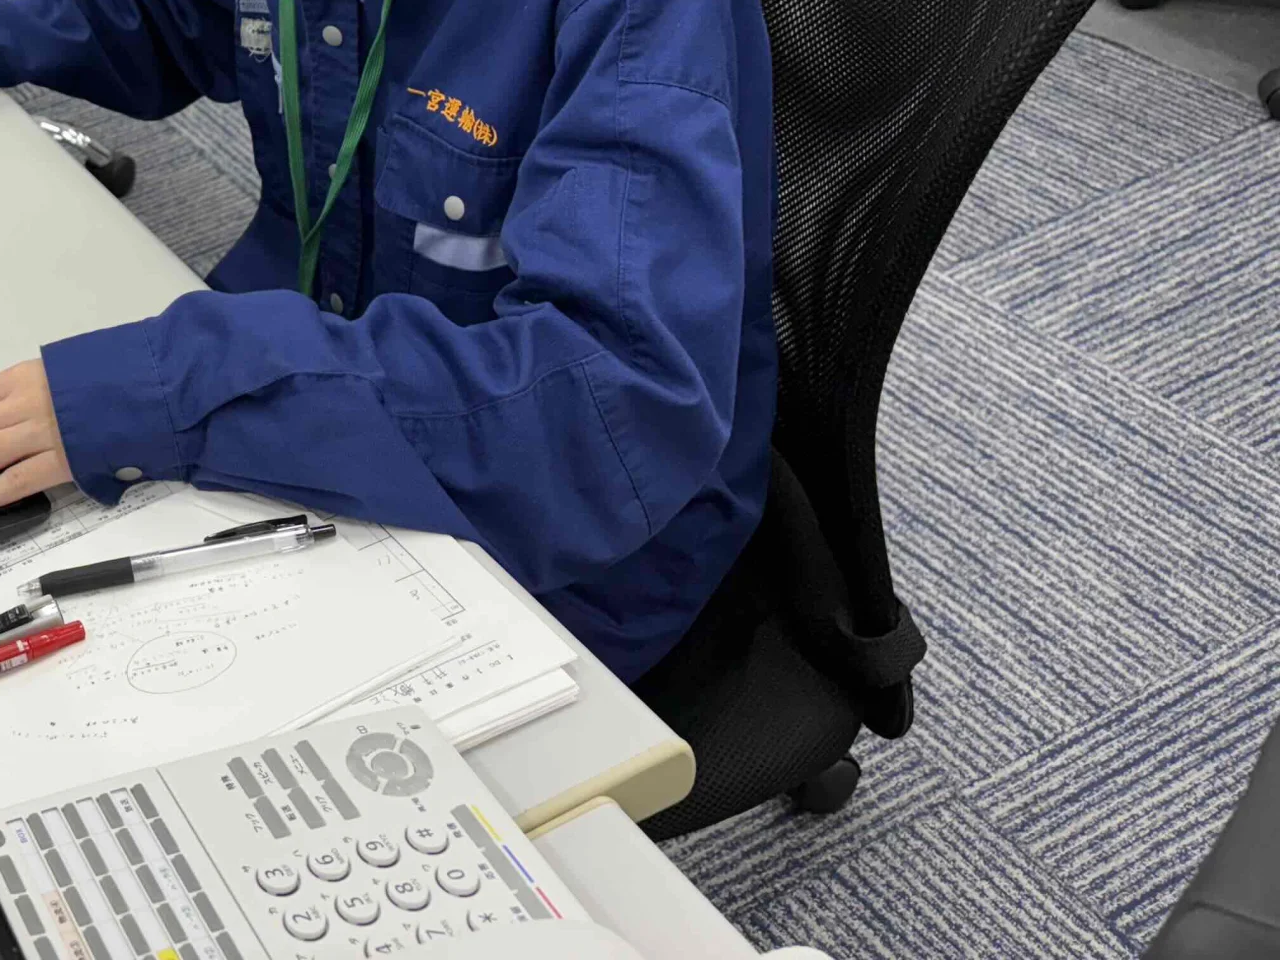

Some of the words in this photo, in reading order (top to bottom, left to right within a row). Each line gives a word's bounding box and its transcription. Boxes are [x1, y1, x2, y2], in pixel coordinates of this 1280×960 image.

[290, 754, 307, 775] メニュー
[253, 762, 273, 785] スピーカ
[315, 795, 332, 812] クリア
[245, 813, 263, 833] フック
[16, 828, 28, 844] BOX
[416, 828, 434, 838] #
[365, 841, 384, 851] 9
[315, 855, 334, 865] 6
[264, 868, 284, 879] 3
[447, 869, 465, 880] 0
[394, 882, 414, 894] 8
[343, 897, 364, 908] 5
[292, 911, 312, 923] 2
[425, 929, 446, 940] 7
[375, 944, 392, 954] 4
